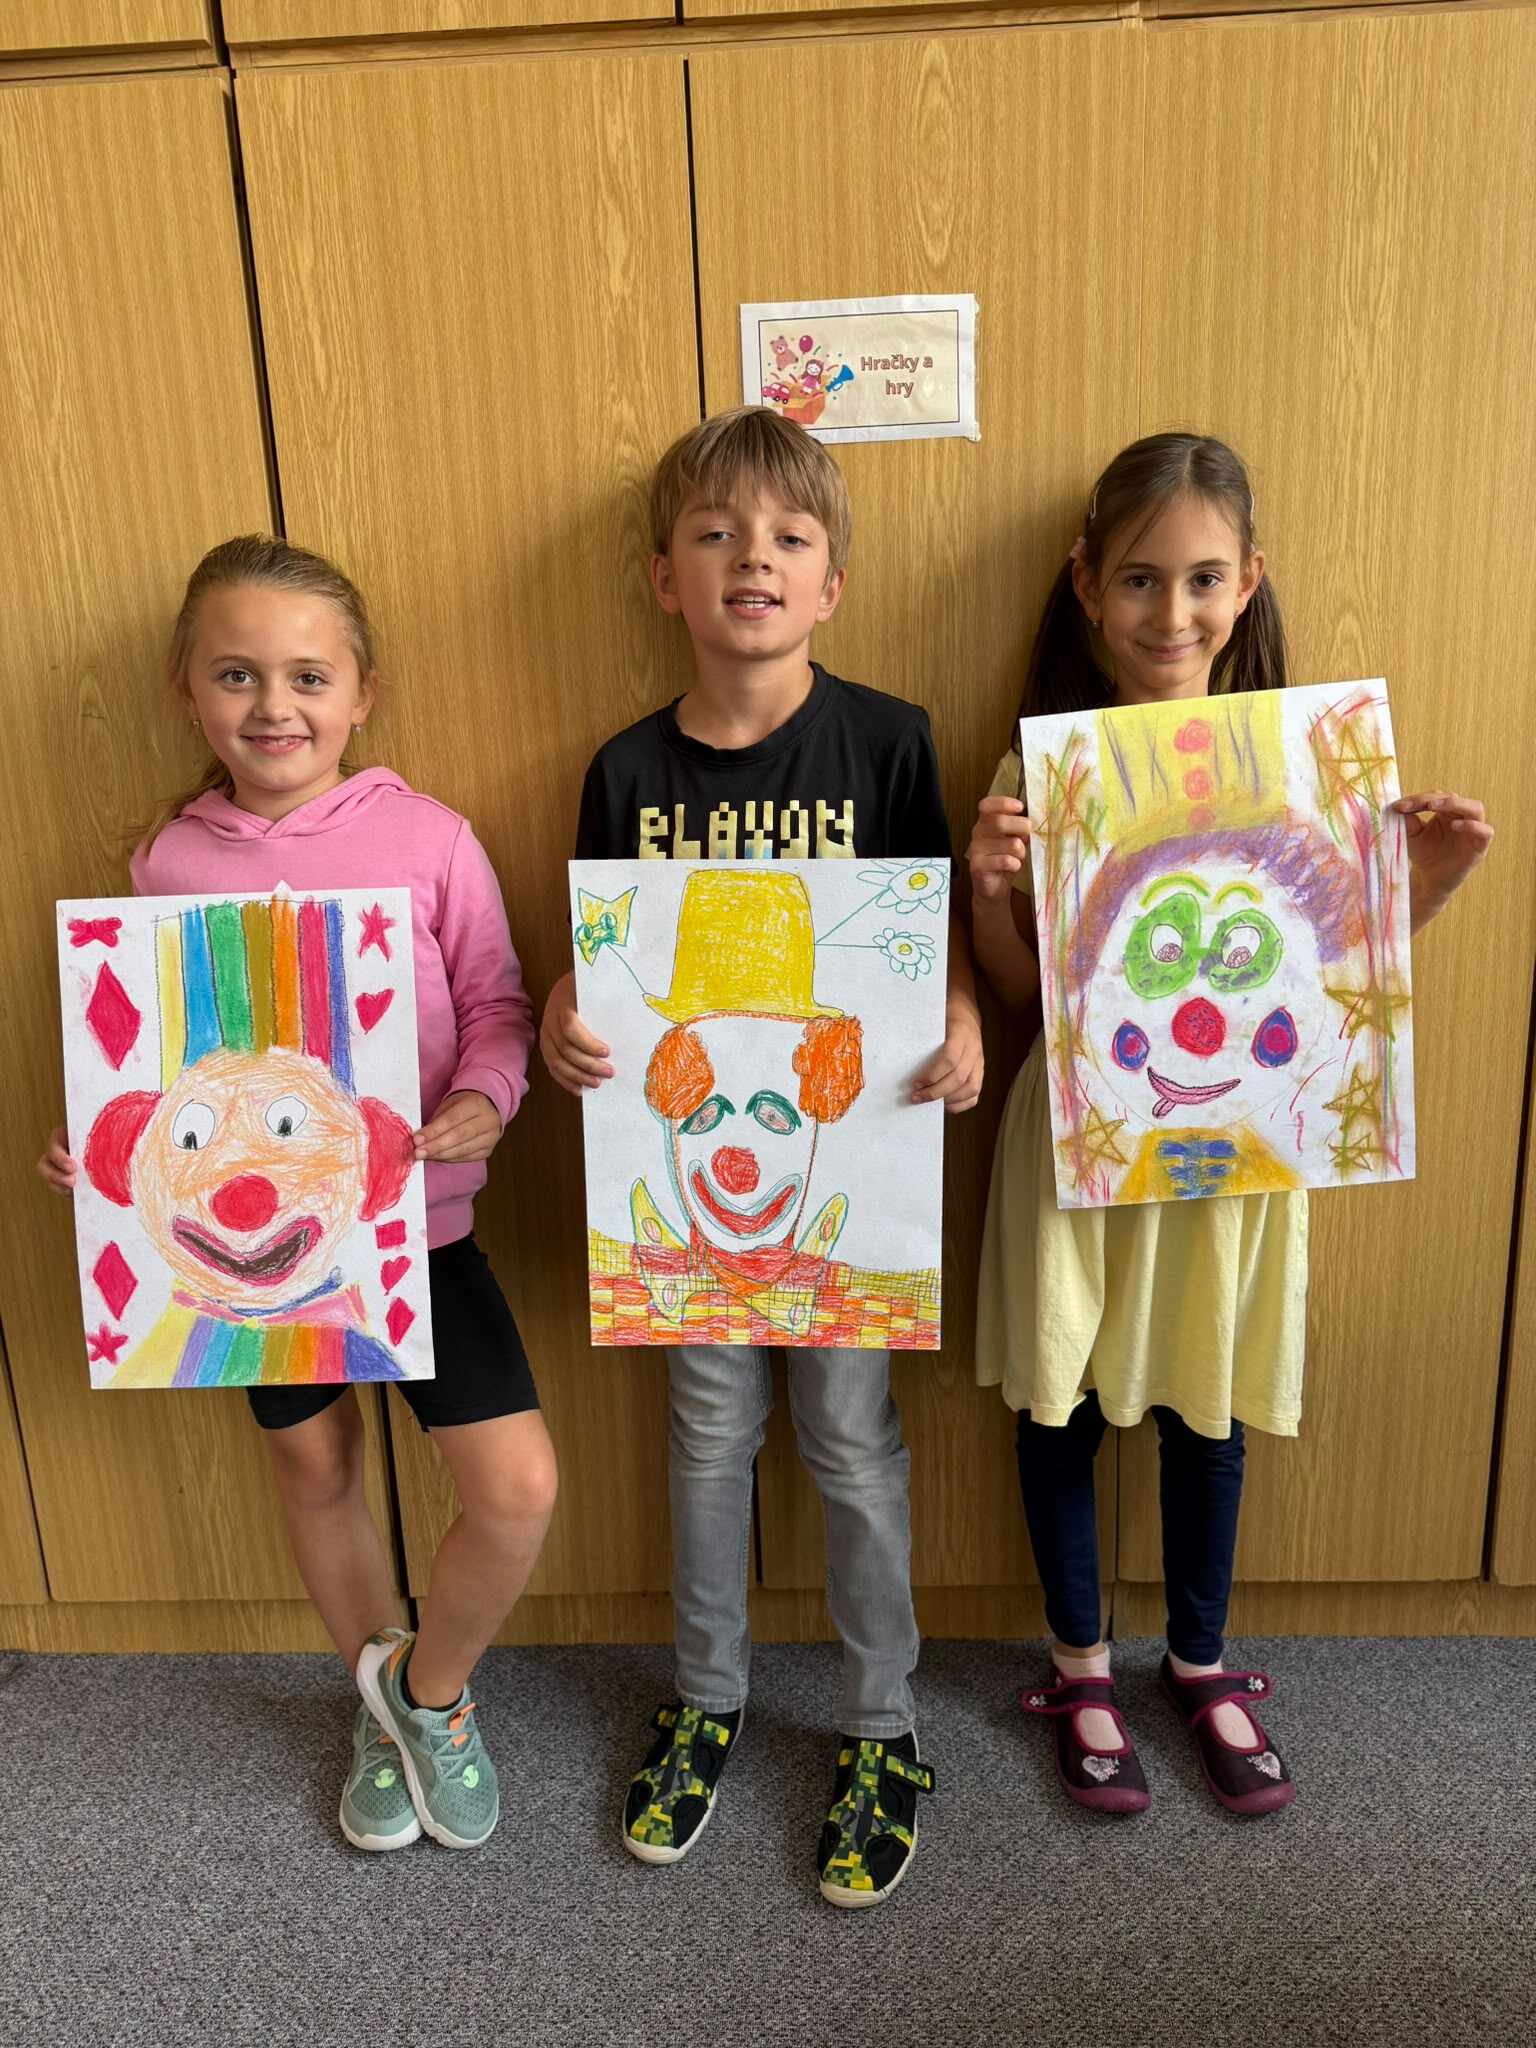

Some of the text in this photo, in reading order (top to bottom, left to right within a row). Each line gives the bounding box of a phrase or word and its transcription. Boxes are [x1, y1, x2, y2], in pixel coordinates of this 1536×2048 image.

[860, 353, 933, 373] Hračky a
[885, 379, 914, 398] hry
